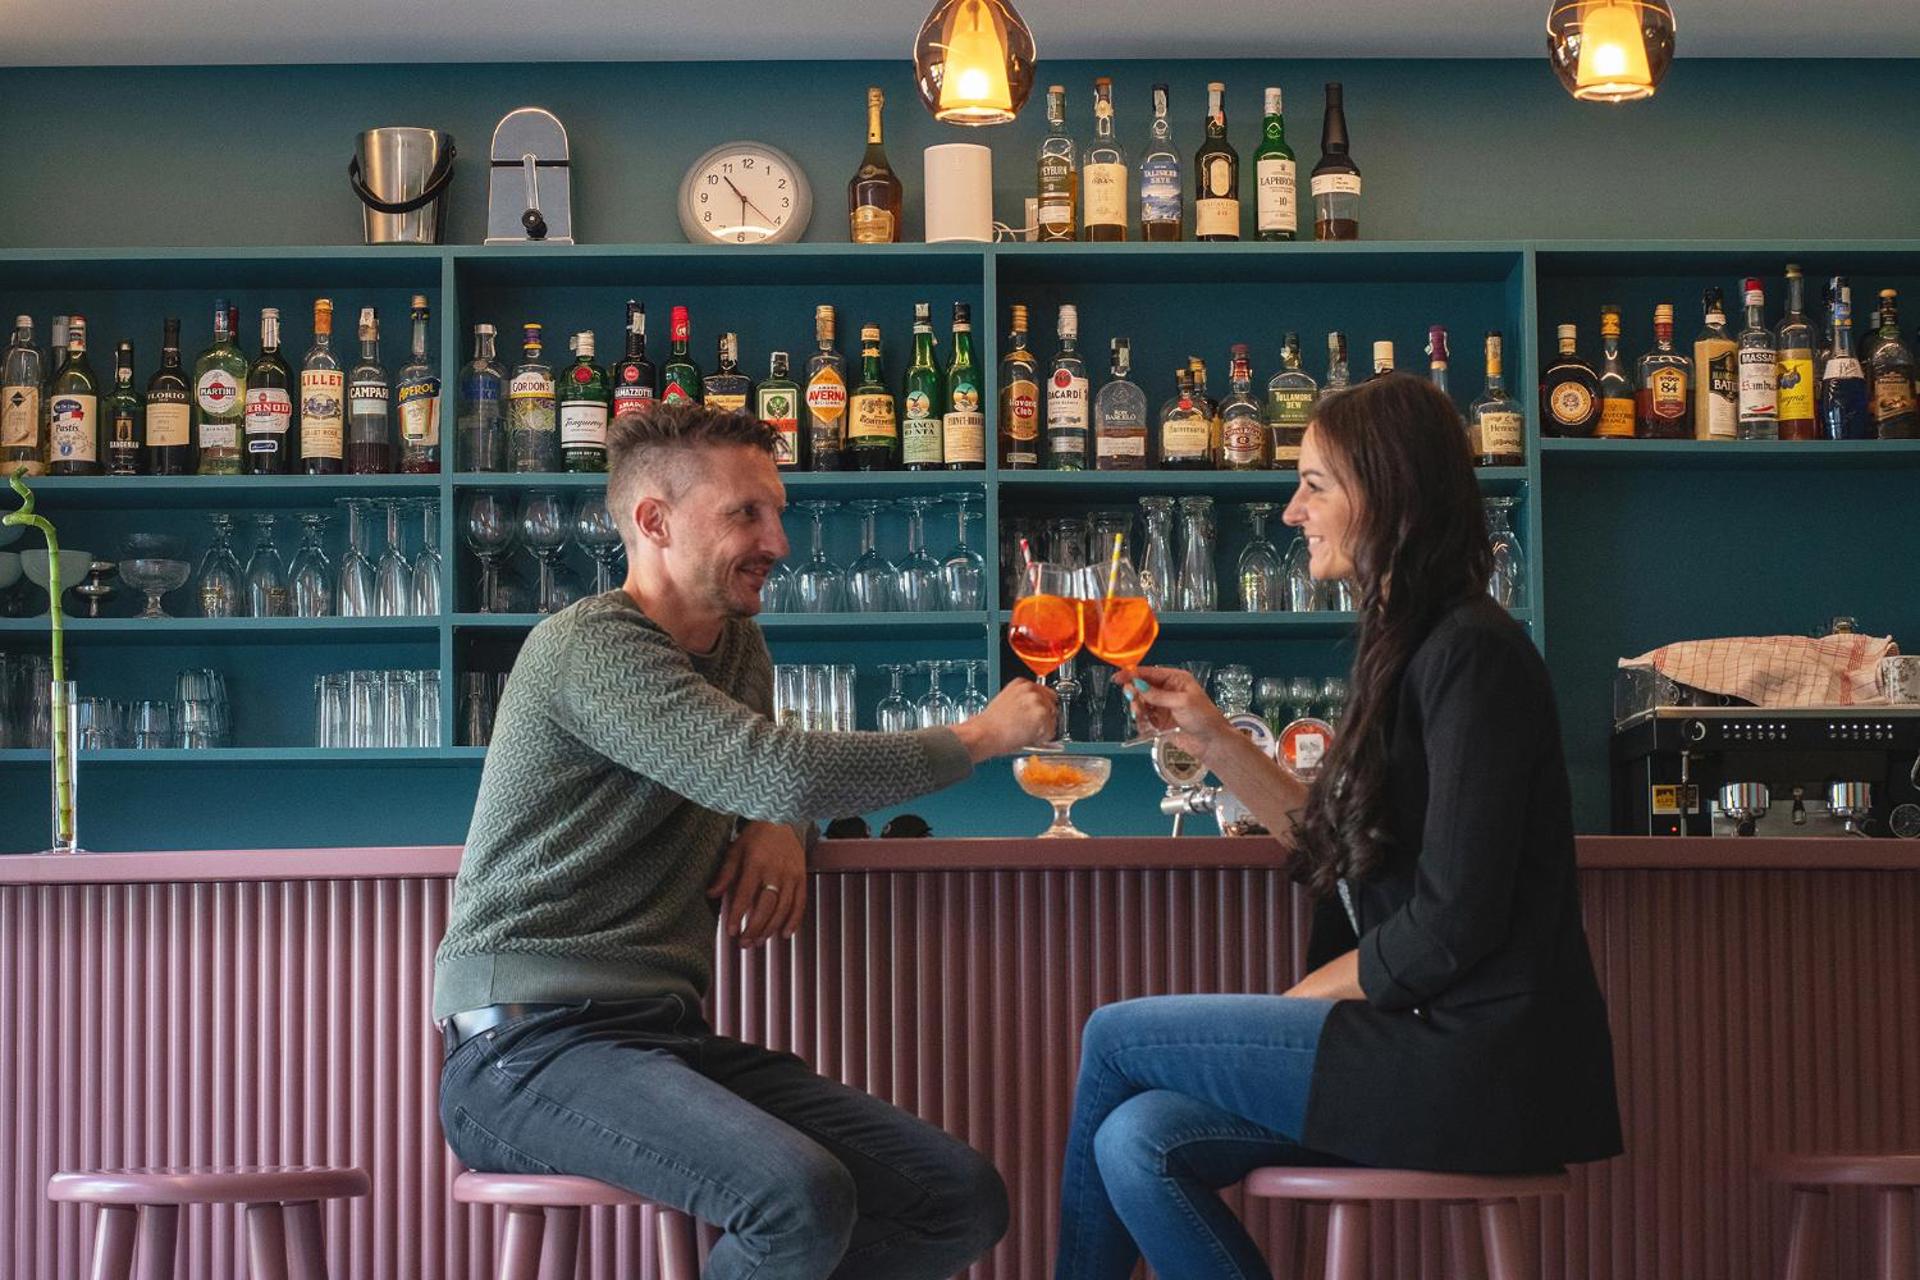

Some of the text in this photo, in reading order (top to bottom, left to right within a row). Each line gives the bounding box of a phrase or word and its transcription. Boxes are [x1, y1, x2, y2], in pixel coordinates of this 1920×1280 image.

[722, 164, 733, 173] 11
[742, 158, 754, 169] 12
[766, 165, 771, 175] 1
[707, 175, 719, 185] 10
[778, 179, 786, 190] 2
[701, 193, 708, 203] 9
[782, 197, 790, 208] 3
[704, 211, 712, 222] 8
[774, 216, 781, 226] 4
[737, 232, 745, 242] 6
[302, 374, 342, 386] LILLET
[200, 387, 235, 396] MARTINI
[1661, 383, 1677, 393] 84
[809, 390, 845, 401] AVERNA
[246, 402, 289, 413] ERNOD
